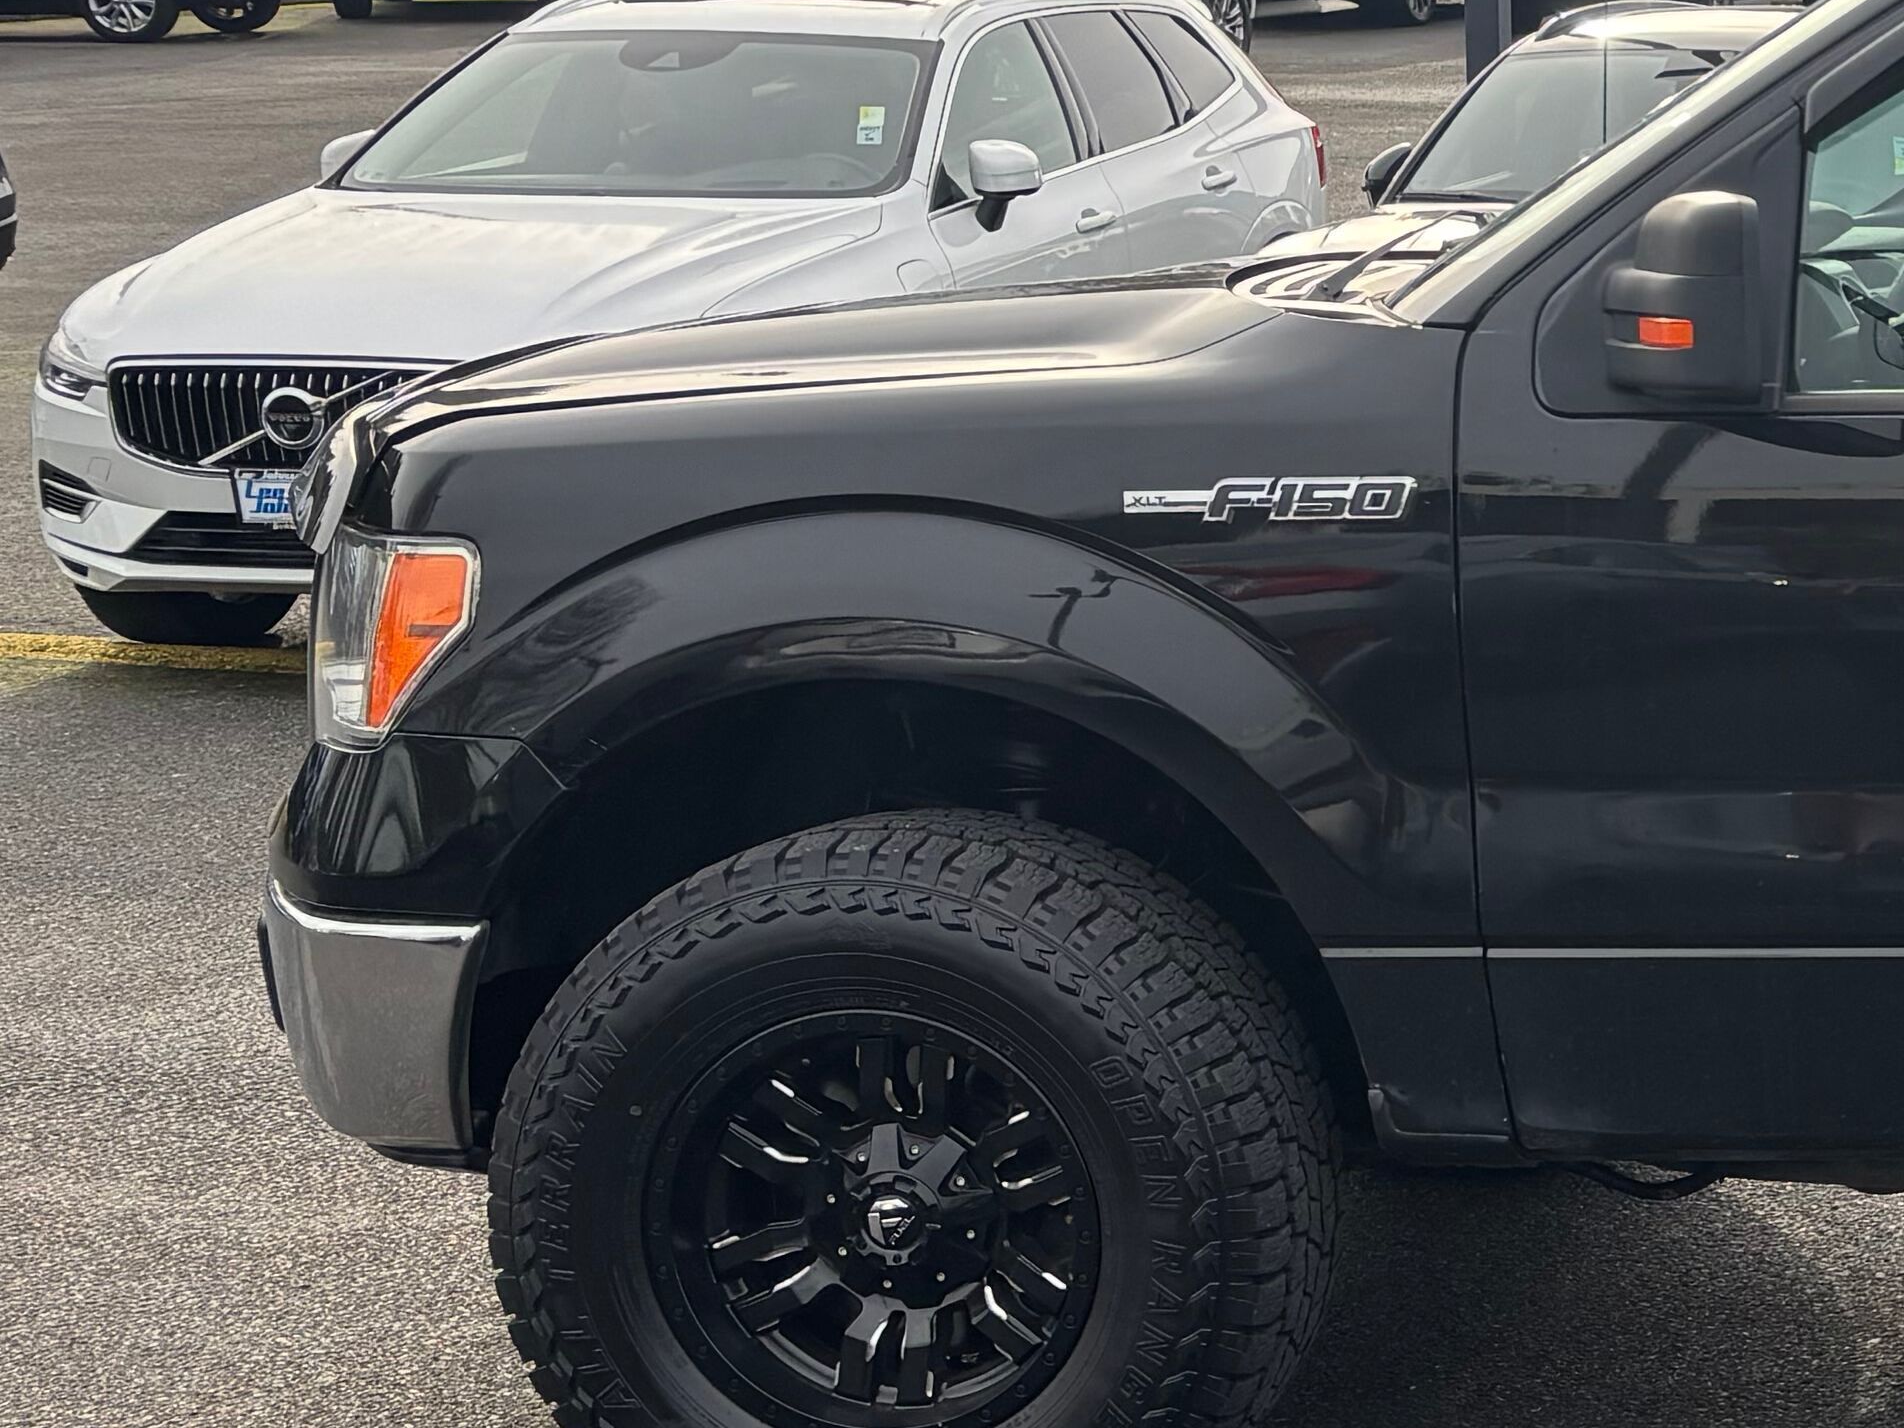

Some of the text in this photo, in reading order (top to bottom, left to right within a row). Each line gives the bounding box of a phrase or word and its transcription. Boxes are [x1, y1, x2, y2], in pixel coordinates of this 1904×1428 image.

[1126, 475, 1418, 523] XLT F-150
[536, 1024, 629, 1281] TERRAIN
[1088, 1054, 1184, 1209] OPEN
[887, 1215, 916, 1246] FUEL
